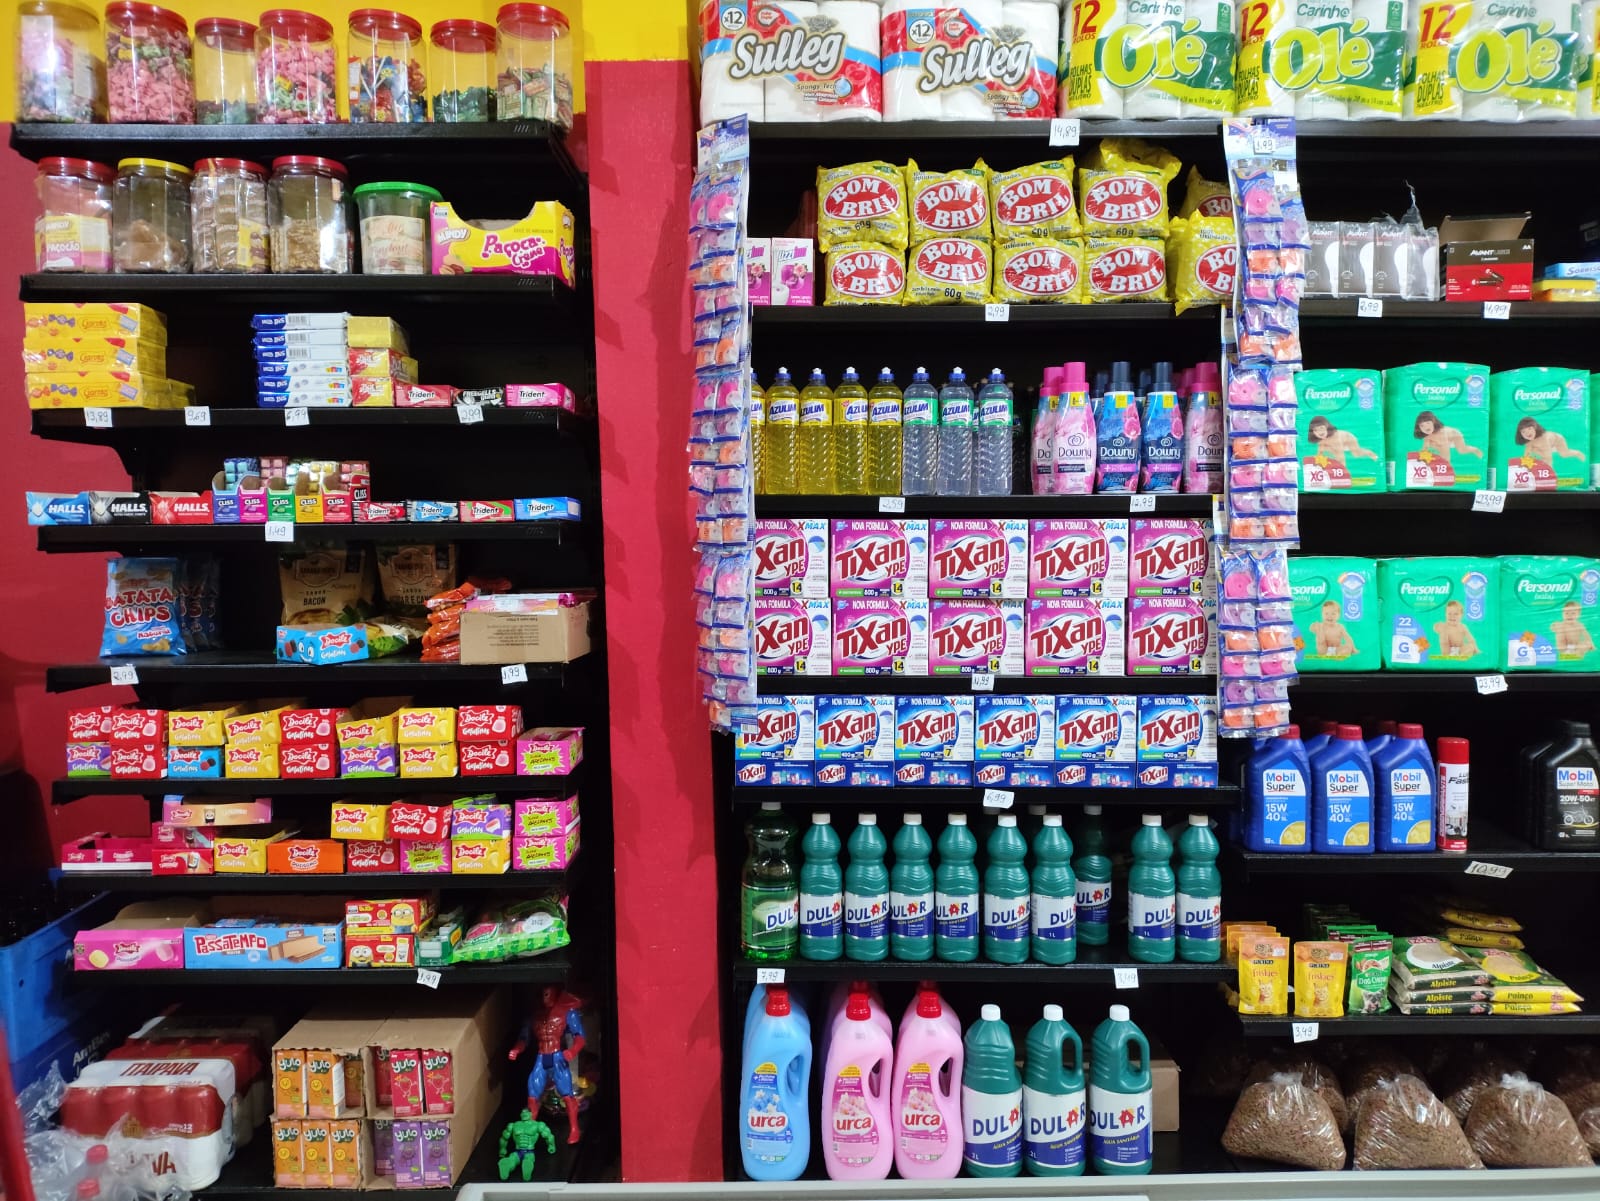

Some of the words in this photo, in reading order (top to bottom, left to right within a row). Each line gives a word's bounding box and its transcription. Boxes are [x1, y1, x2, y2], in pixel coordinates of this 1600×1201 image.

[1296, 4, 1351, 18] Carinho
[1072, 0, 1101, 36] 12
[1240, 2, 1269, 43] 12
[1422, 4, 1458, 43] 12
[730, 29, 846, 78] Sulleg
[1102, 17, 1207, 88] Olé
[1269, 18, 1374, 90] Olé
[1456, 19, 1563, 93] Olé
[921, 39, 1032, 93] Sulleg
[1053, 124, 1077, 139] 14,89
[831, 177, 880, 205] BOM
[1001, 179, 1053, 209] BOM
[840, 193, 897, 218] BRIL
[1013, 196, 1070, 223] BRIL
[923, 241, 974, 264] BOM
[1098, 249, 1150, 277] BOM
[935, 257, 987, 283] BRIL
[1109, 267, 1164, 293] BRIL
[408, 391, 435, 399] Trident
[519, 391, 545, 399] Trident
[1305, 386, 1350, 400] Personal
[1413, 383, 1461, 396] Personal
[1514, 388, 1561, 401] Personal
[769, 403, 797, 415] AZULIM
[872, 403, 900, 416] AZULIM
[942, 404, 971, 416] AZULIM
[981, 404, 1009, 415] AZULIM
[1058, 447, 1092, 461] Downy
[1100, 446, 1136, 460] Downy
[1148, 446, 1181, 460] Downy
[1332, 468, 1343, 477] 18
[1413, 465, 1428, 479] XG
[1435, 464, 1447, 474] 18
[1538, 469, 1549, 478] 18
[1310, 470, 1324, 483] XG
[1515, 471, 1530, 484] XG
[354, 488, 368, 500] CLISS
[48, 504, 84, 513] HALLS
[111, 503, 147, 512] HALLS
[174, 503, 209, 512] HALLS
[473, 506, 499, 515] Trident
[528, 503, 554, 512] Trident
[851, 521, 864, 531] NOVA
[835, 538, 906, 580] TiXan
[934, 538, 1005, 580] TiXan
[1034, 538, 1105, 580] TiXan
[1135, 538, 1205, 580] TiXan
[1400, 582, 1450, 595] Personal
[1518, 579, 1573, 594] Personal
[110, 606, 170, 627] CHIPS
[1399, 617, 1412, 626] 22
[321, 633, 351, 649] Docile
[837, 616, 907, 658] TiXan
[1031, 616, 1102, 658] TiXan
[1398, 642, 1410, 654] G
[1517, 646, 1528, 658] G
[1540, 645, 1552, 654] 22
[72, 714, 100, 727] Docile
[173, 718, 203, 730] Docile
[286, 714, 316, 727] Docile
[404, 714, 435, 726] Docile
[461, 712, 493, 724] Docile
[818, 712, 876, 746] TiXan
[979, 712, 1037, 746] TiXan
[738, 764, 766, 781] TiXan
[896, 764, 925, 781] TiXan
[1139, 765, 1168, 782] TiXan
[1266, 771, 1296, 783] Mobil
[1329, 772, 1359, 785] Mobil
[1394, 770, 1421, 783] Mobil
[1558, 770, 1593, 781] Mobil
[1266, 782, 1296, 793] Super
[1330, 783, 1358, 794] Super
[1394, 781, 1420, 793] Super
[1266, 803, 1287, 813] 15W
[1329, 804, 1351, 814] 15W
[1394, 803, 1414, 813] 15W
[337, 809, 367, 822] Docile
[456, 810, 488, 822] Docile
[1266, 813, 1281, 822] 40
[1329, 813, 1344, 823] 40
[1394, 812, 1408, 821] 40
[220, 845, 247, 856] Docile
[848, 900, 888, 921] DULAR
[1430, 979, 1457, 988] Alpiste
[1425, 993, 1453, 1003] Alpiste
[120, 1062, 200, 1077] ITAIPAVA
[750, 1114, 786, 1128] urca
[837, 1117, 872, 1130] urca
[905, 1113, 941, 1127] urca
